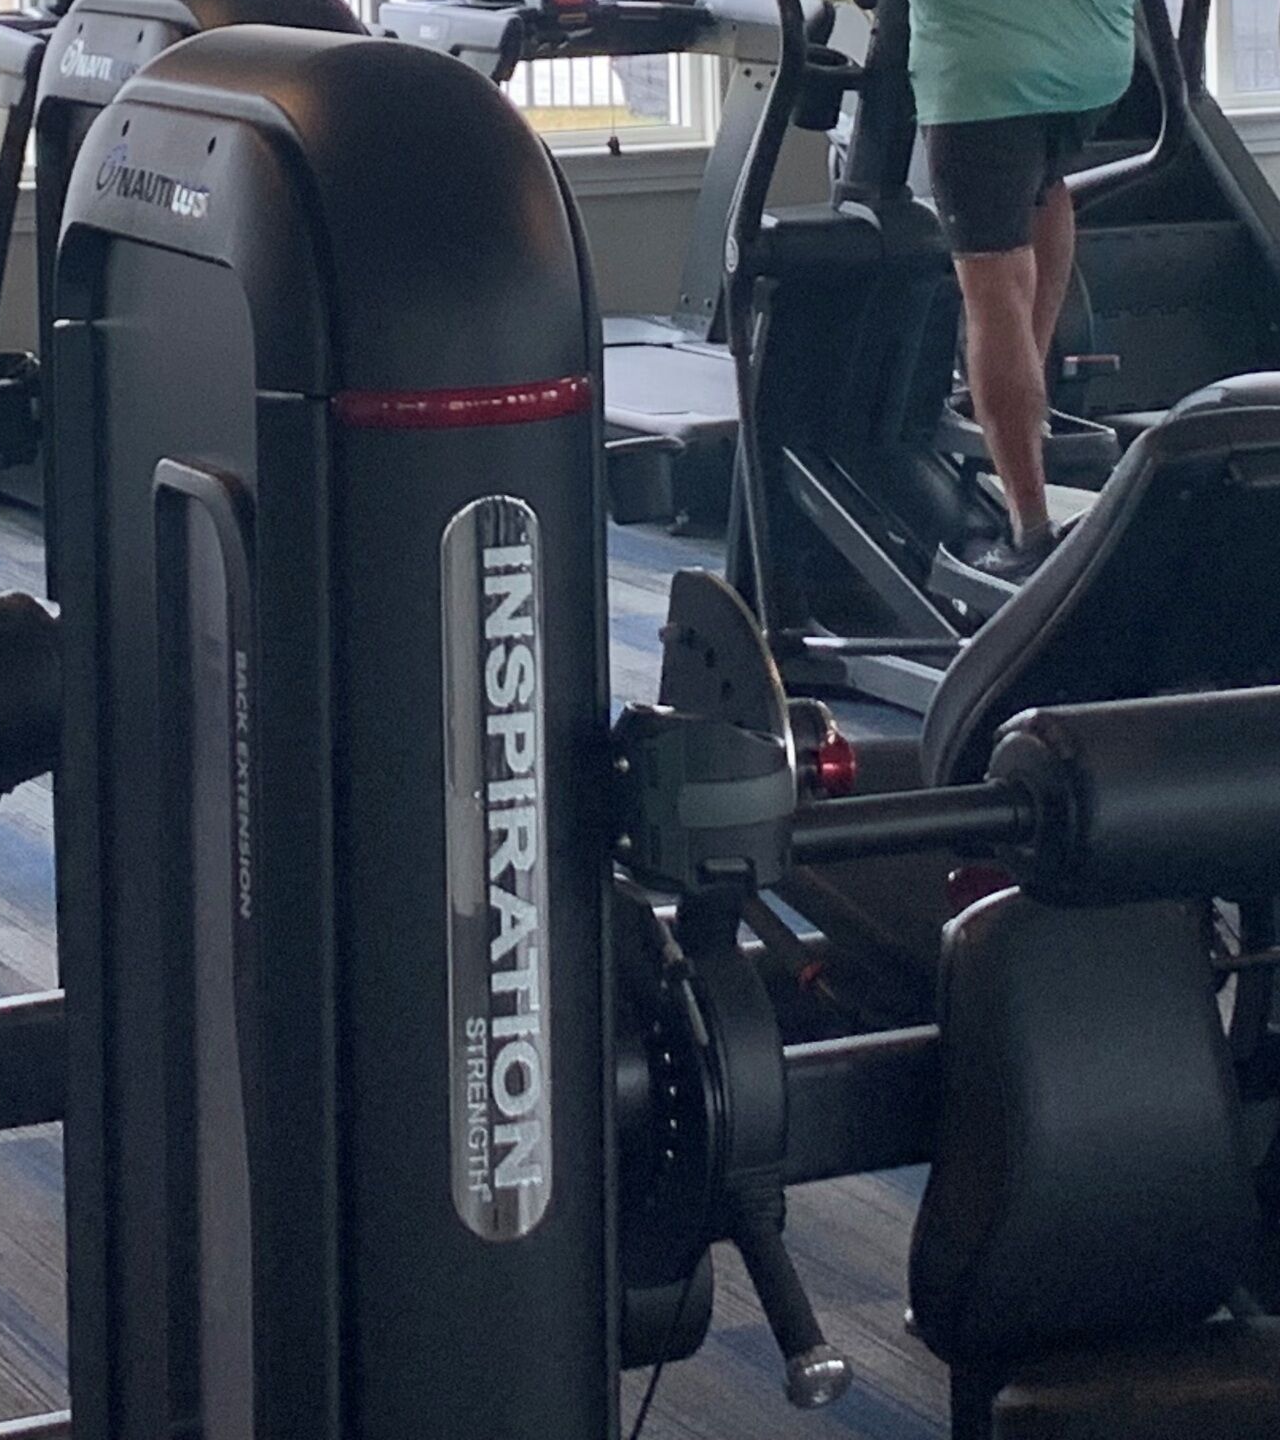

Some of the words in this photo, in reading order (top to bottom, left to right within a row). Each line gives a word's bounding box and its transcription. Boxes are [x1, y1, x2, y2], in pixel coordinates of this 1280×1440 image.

[117, 164, 210, 218] NAUTILUS
[235, 650, 249, 733] BACK
[237, 741, 252, 919] EXTENSION
[483, 544, 543, 1188] INSPIRATION
